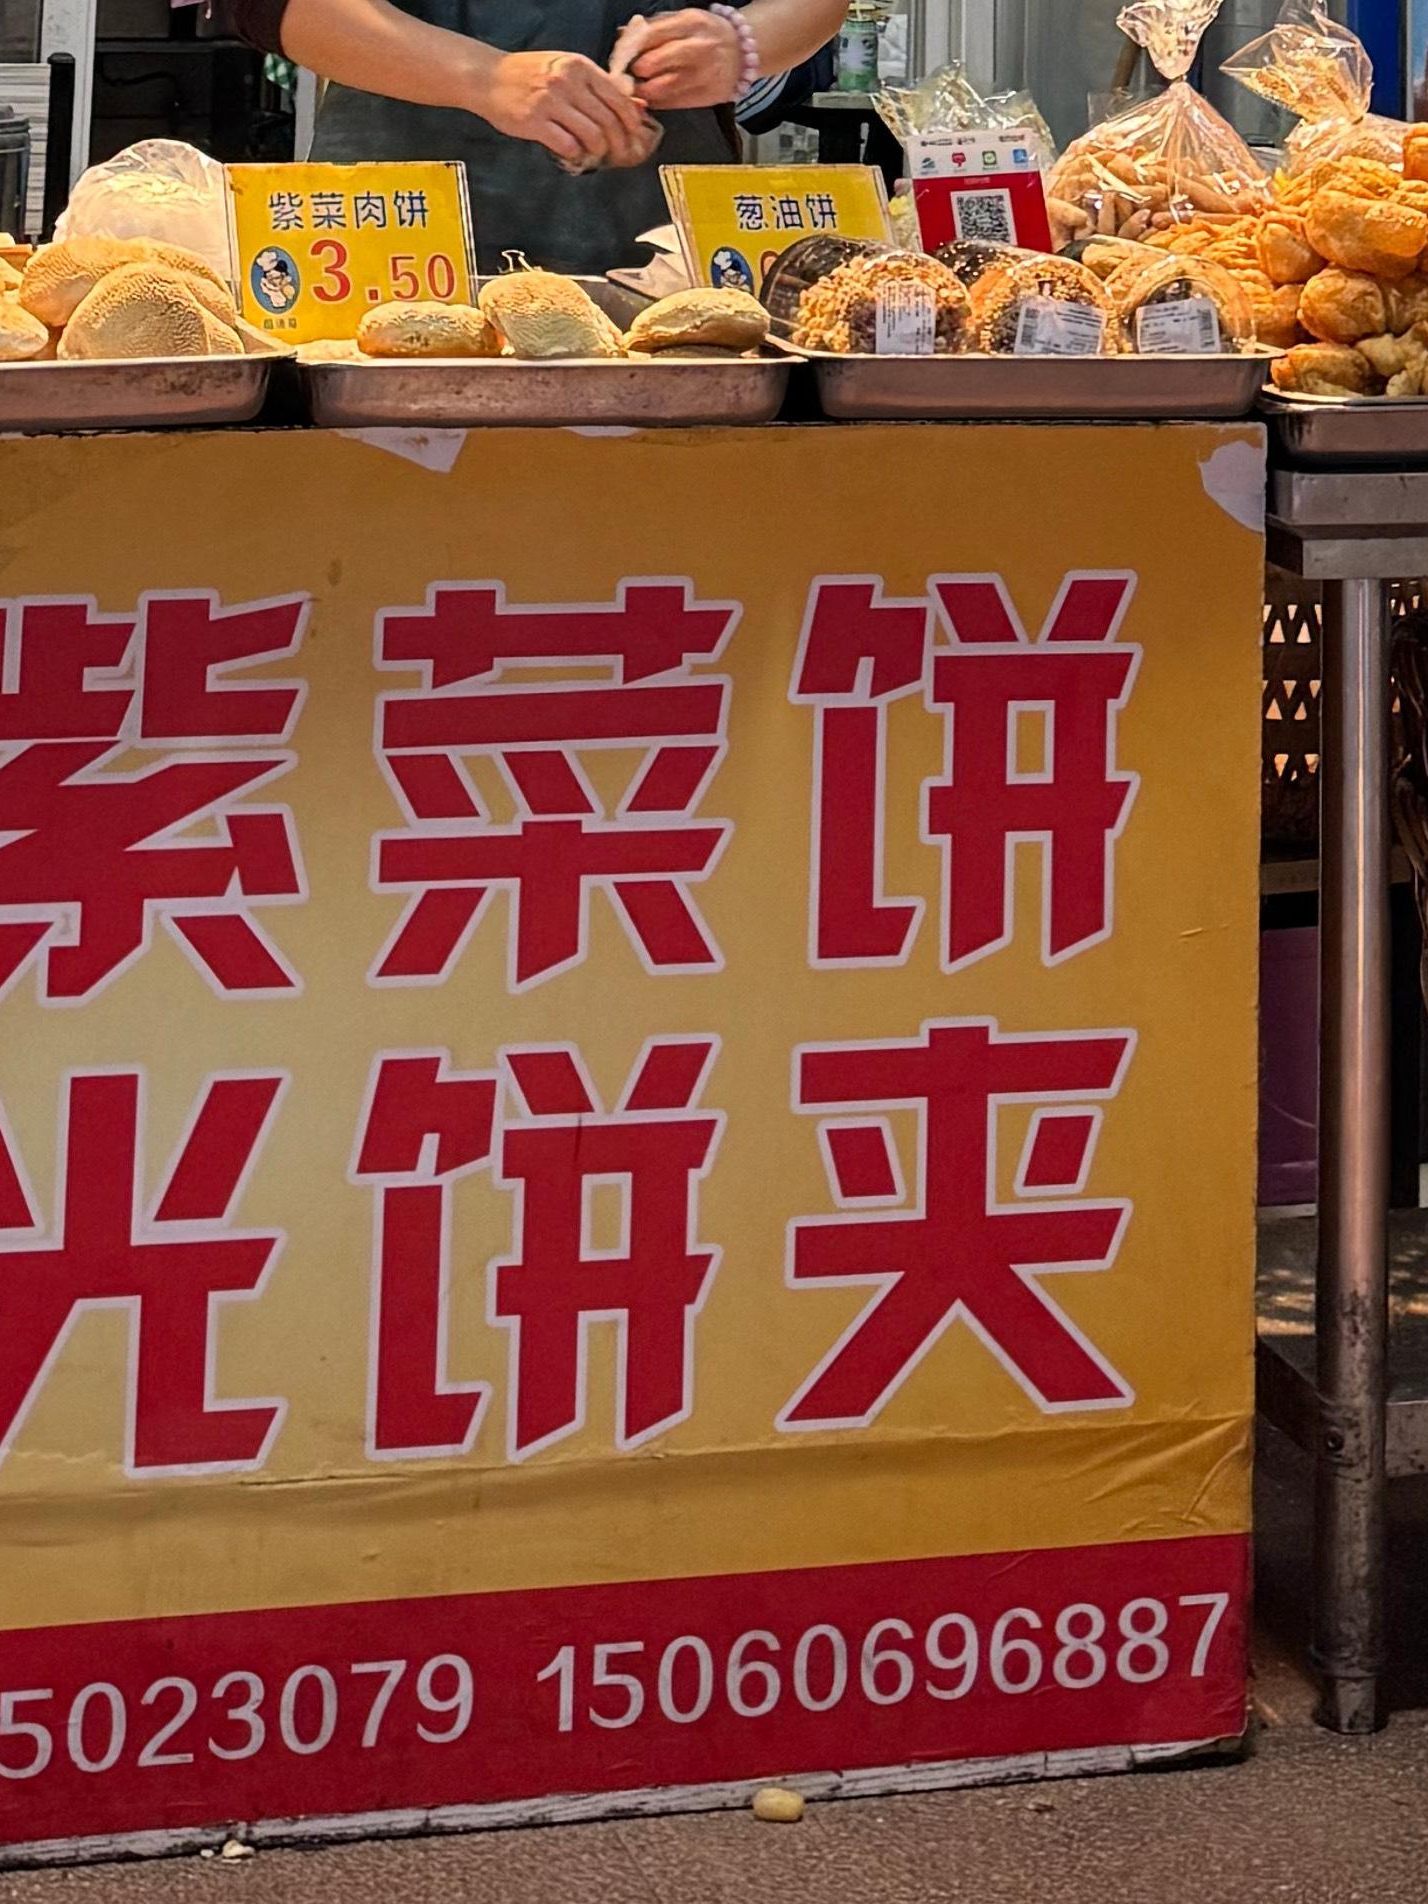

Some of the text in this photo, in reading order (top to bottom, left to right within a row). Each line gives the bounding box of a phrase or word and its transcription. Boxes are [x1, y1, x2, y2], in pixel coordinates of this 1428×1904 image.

[268, 191, 430, 232] 紫菜肉饼
[733, 193, 838, 232] 葱油饼
[310, 239, 456, 302] 3.50
[535, 1592, 1230, 1734] 15060696887
